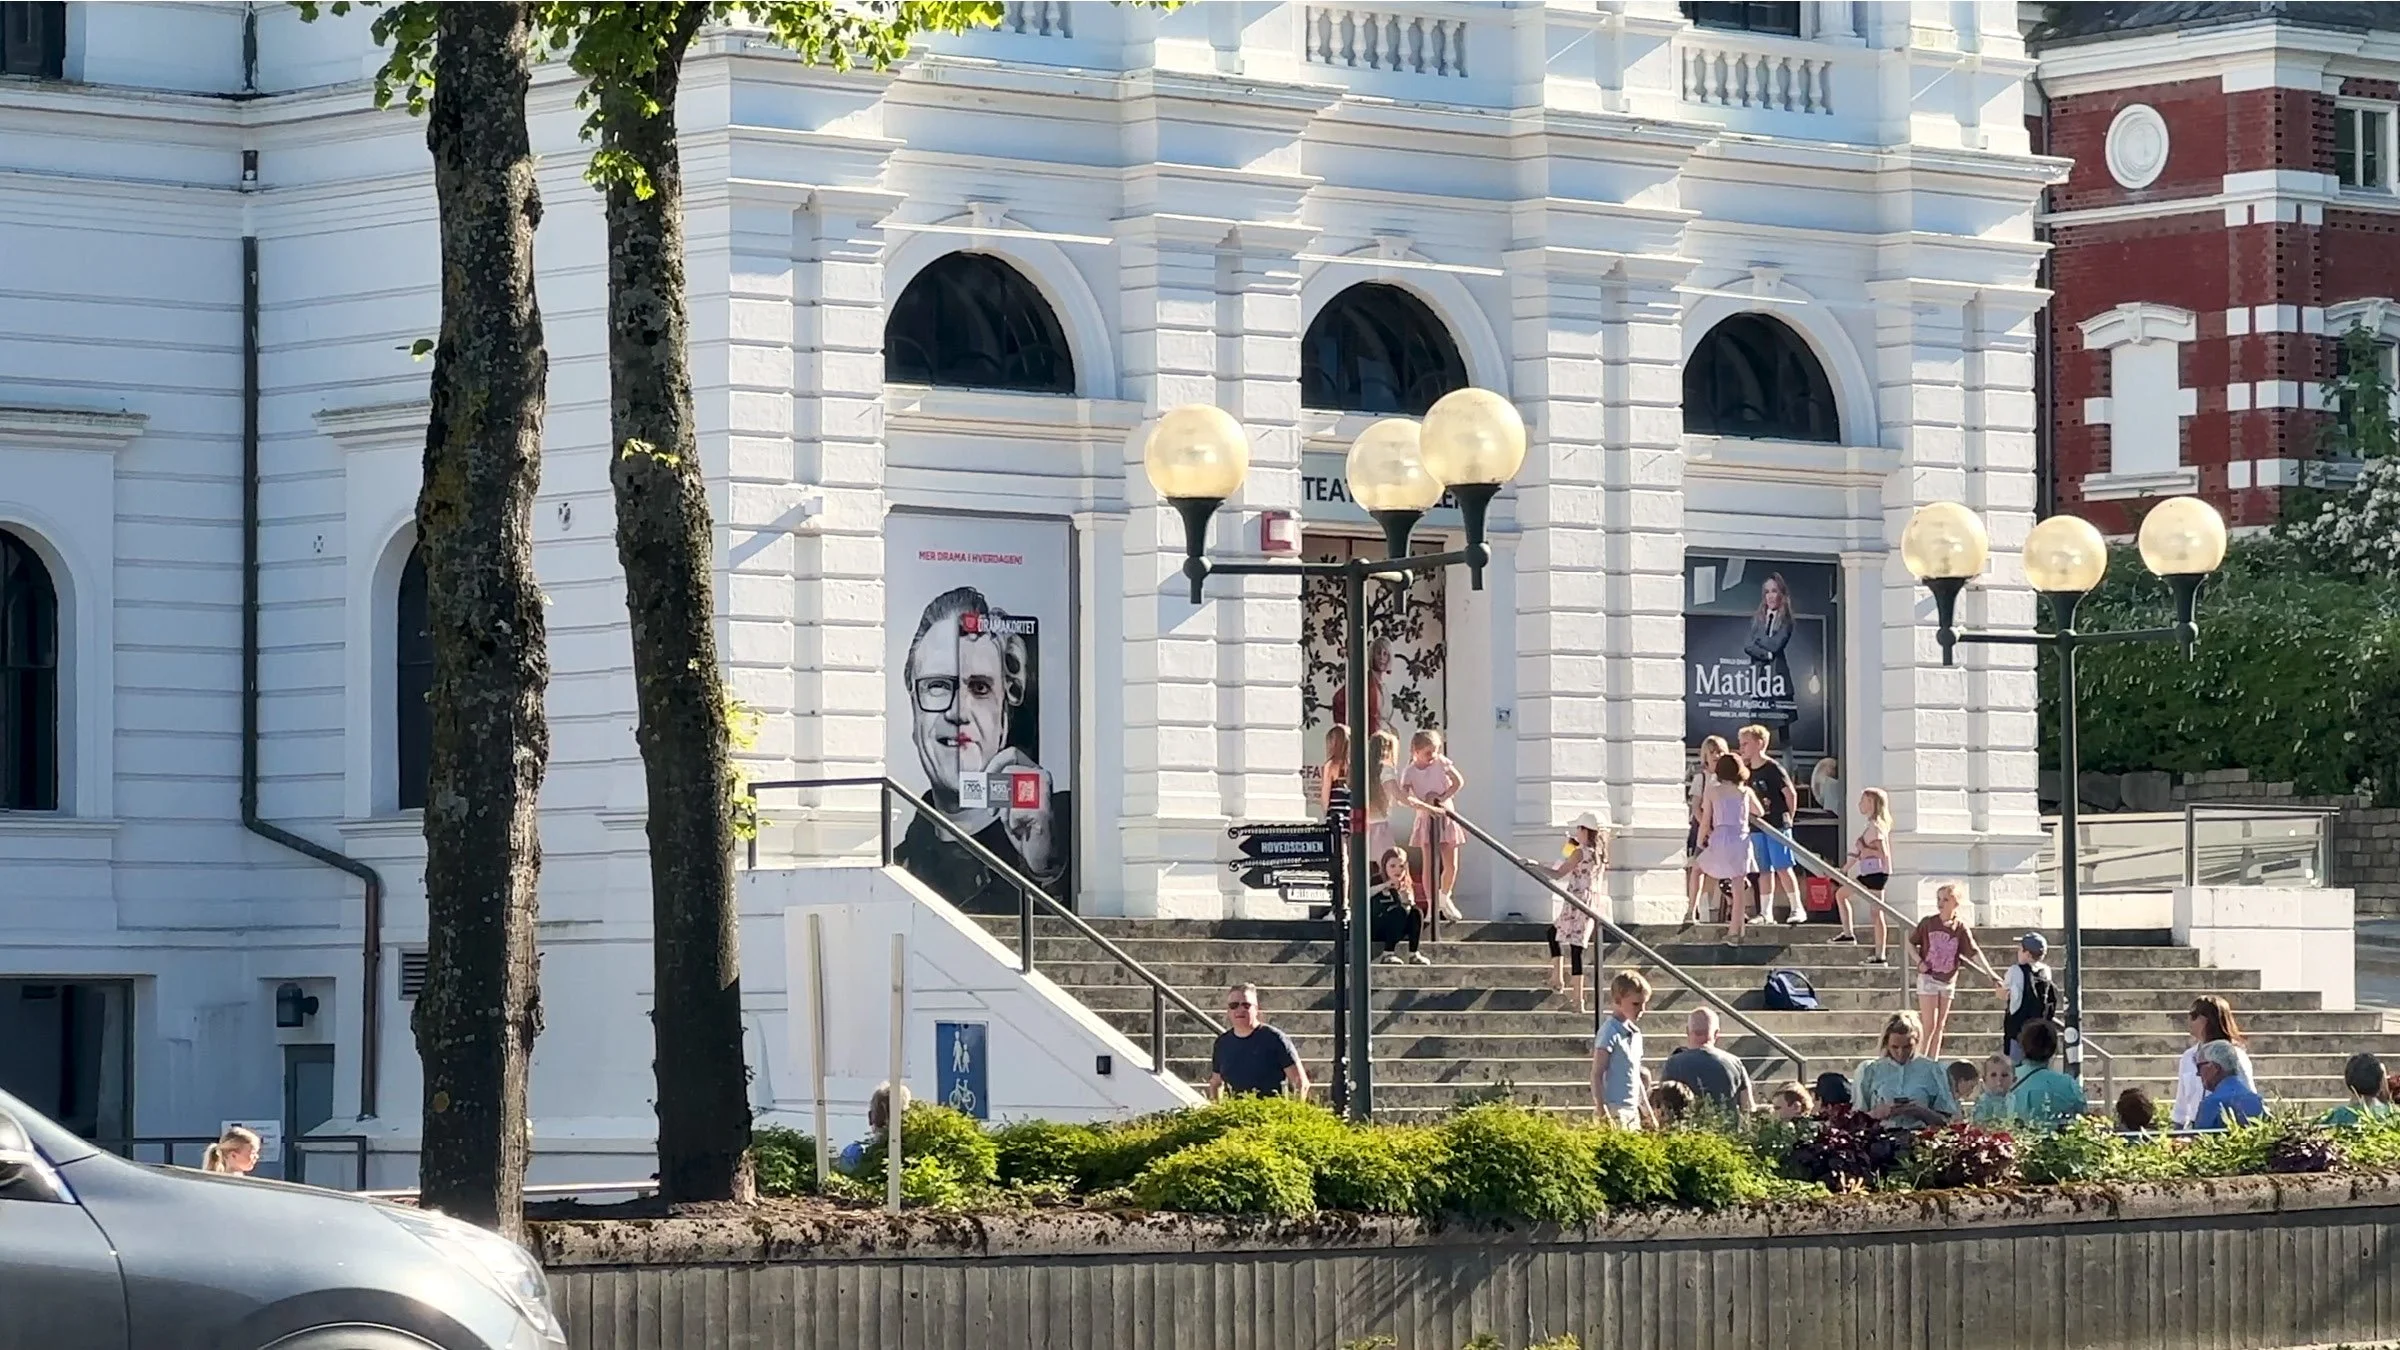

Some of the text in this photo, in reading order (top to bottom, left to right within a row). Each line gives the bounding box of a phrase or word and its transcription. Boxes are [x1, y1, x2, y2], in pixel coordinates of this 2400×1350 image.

[919, 551, 935, 561] MER
[937, 552, 966, 562] DRAMA
[972, 553, 1022, 565] HVERDAGEN!
[1695, 663, 1786, 698] Matilda
